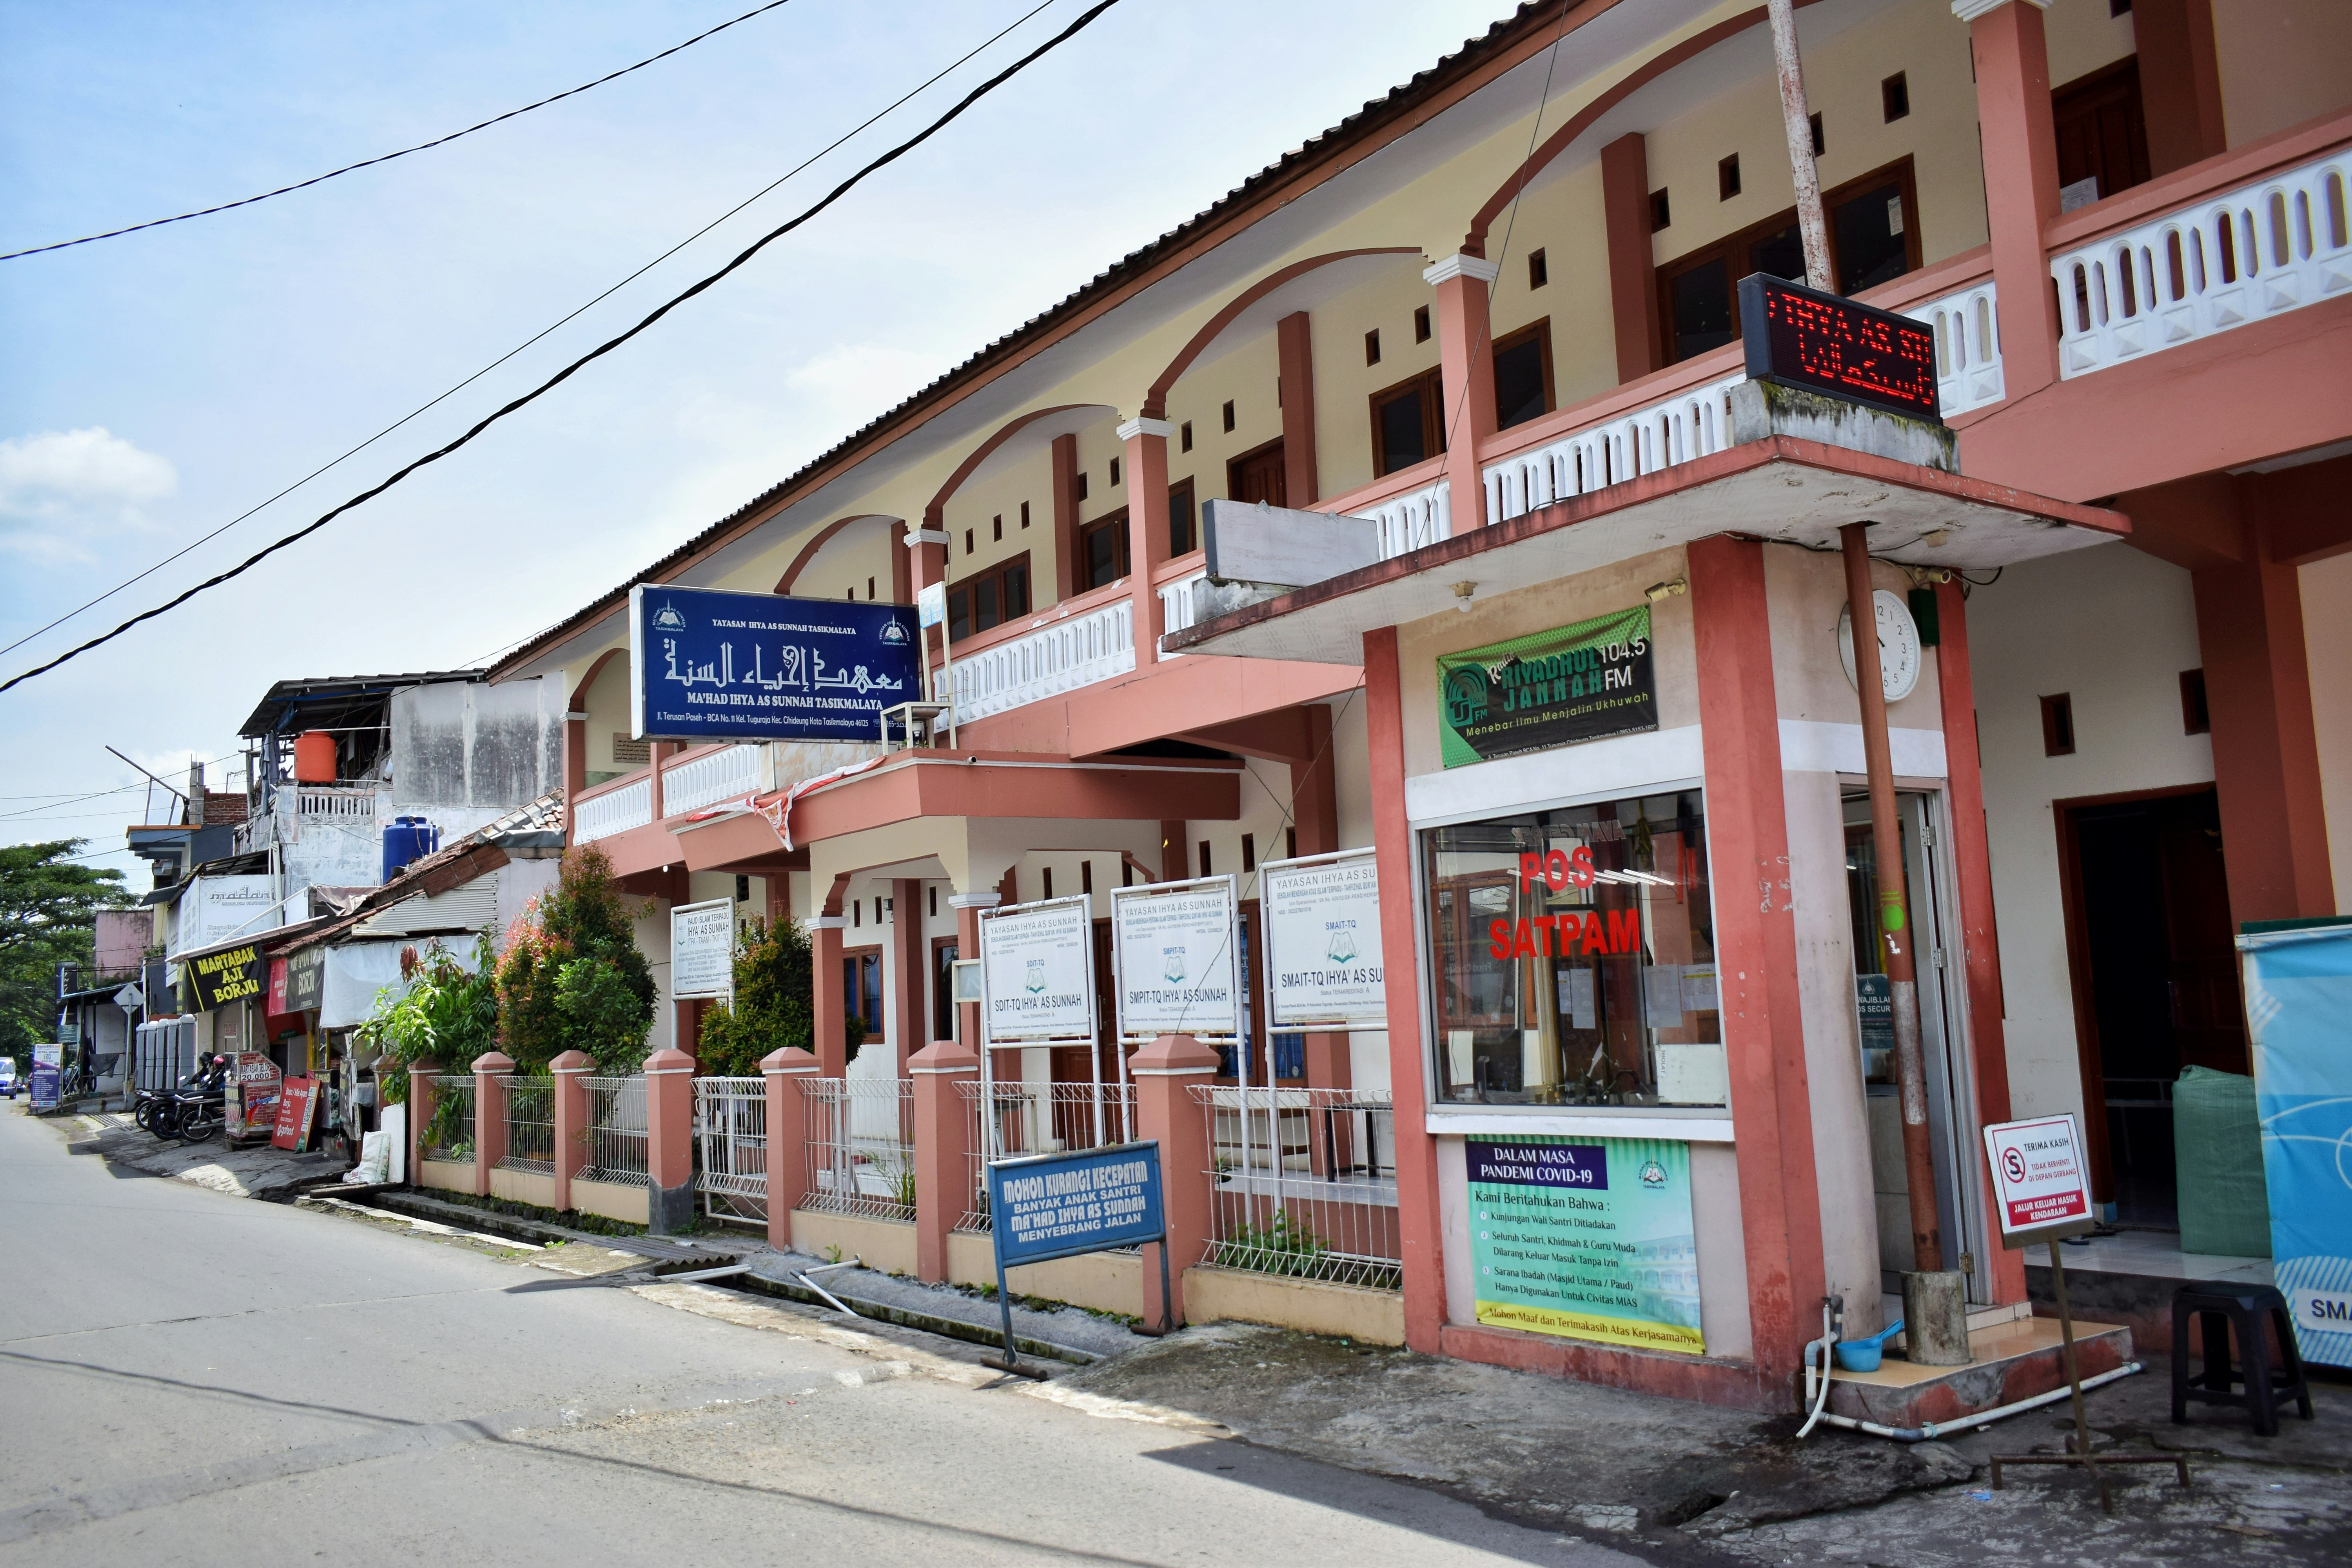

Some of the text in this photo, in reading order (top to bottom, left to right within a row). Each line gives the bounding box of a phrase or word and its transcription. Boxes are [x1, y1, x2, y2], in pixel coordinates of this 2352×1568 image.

[1877, 606, 1884, 616] 12
[712, 619, 746, 628] YAYASAN
[778, 623, 807, 632] SUNNAH
[809, 625, 856, 635] TASIKMALAYA
[1897, 625, 1902, 635] 2
[1902, 643, 1906, 653] 3
[1501, 646, 1601, 689] RIYADHUL
[1601, 636, 1646, 663] 104.5
[1900, 661, 1904, 671] 4
[1884, 676, 1888, 687] 6
[1893, 673, 1898, 683] 5
[1503, 666, 1632, 711] JANNAH FM
[687, 692, 883, 710] MA'HAD IHYA AS SUNNAH TASIKMALAYA
[663, 712, 685, 721] Terusan
[686, 713, 702, 721] Paseh
[707, 713, 719, 722] BCA
[720, 714, 730, 722] No.
[747, 715, 771, 724] Tuguraja
[771, 715, 782, 724] Kec.
[783, 716, 809, 726] Cihideung
[809, 717, 822, 725] Kota
[823, 717, 854, 728] Tasikmalaya
[1466, 692, 1649, 737] Menebar Ilmu Menjalin Ukhuwah
[1475, 709, 1488, 721] FM
[1520, 846, 1595, 894] POS
[1277, 870, 1359, 889] YAYASAN IHYA AS
[1327, 885, 1342, 893] TERPADU
[1125, 898, 1222, 916] YAYASAN IHYA AS SUNNAH
[698, 915, 710, 923] ISLAM
[711, 912, 729, 921] TERPADU
[991, 916, 1077, 935] YAYASAN IHYA AS SUNNAH
[701, 924, 708, 935] AS
[709, 921, 729, 933] SUNNAH
[1489, 908, 1640, 960] SATPAM
[712, 934, 720, 942] TKIT
[198, 946, 257, 975] MARTABAK
[222, 967, 245, 984] AJI
[1281, 968, 1366, 987] SMAIT-TQ IHYA' AS
[213, 979, 259, 1003] BORJU
[1129, 988, 1226, 1004] SMPIT-TQ IHYA' AS SUNNAH
[995, 993, 1082, 1012] SDIT-TQ IHYA' AS SUNNAH
[242, 1073, 269, 1081] 20.000
[281, 1125, 294, 1136] gofood
[2024, 1138, 2069, 1152] TERIMA KASIH
[1494, 1147, 1575, 1164] DALAM MASA
[2031, 1158, 2070, 1171] TIDAK BERHENTI
[1003, 1161, 1148, 1203] MOHON KURANGI KECEPATAN
[1481, 1164, 1593, 1183] PANDEMI COVID-19
[2036, 1172, 2052, 1181] DEPAN
[2053, 1168, 2076, 1178] GERBANG
[1014, 1185, 1141, 1214] BANYAK ANAK SANTRI
[1475, 1191, 1604, 1211] Kami Beritahukan Bahwa
[2014, 1194, 2077, 1213] JALUR KELUAR MASUK
[1011, 1196, 1146, 1232] MA'HAD IHYA AS SUNNAH
[1491, 1212, 1616, 1230] Kunjungan Wali Santri Ditiadakan
[2030, 1207, 2067, 1220] KENDARAAN
[1019, 1213, 1142, 1243] MENYEBRANG JALAN
[1492, 1231, 1635, 1253] Seluruh Santri, Khidmah & Guru Muda
[1495, 1282, 1638, 1308] Hanya Digunakan Untuk Civitas MIAS
[2311, 1299, 2352, 1321] SM
[1490, 1308, 1697, 1346] Mohon Maaf dan Terimakasih Atas Kerjasamanya
